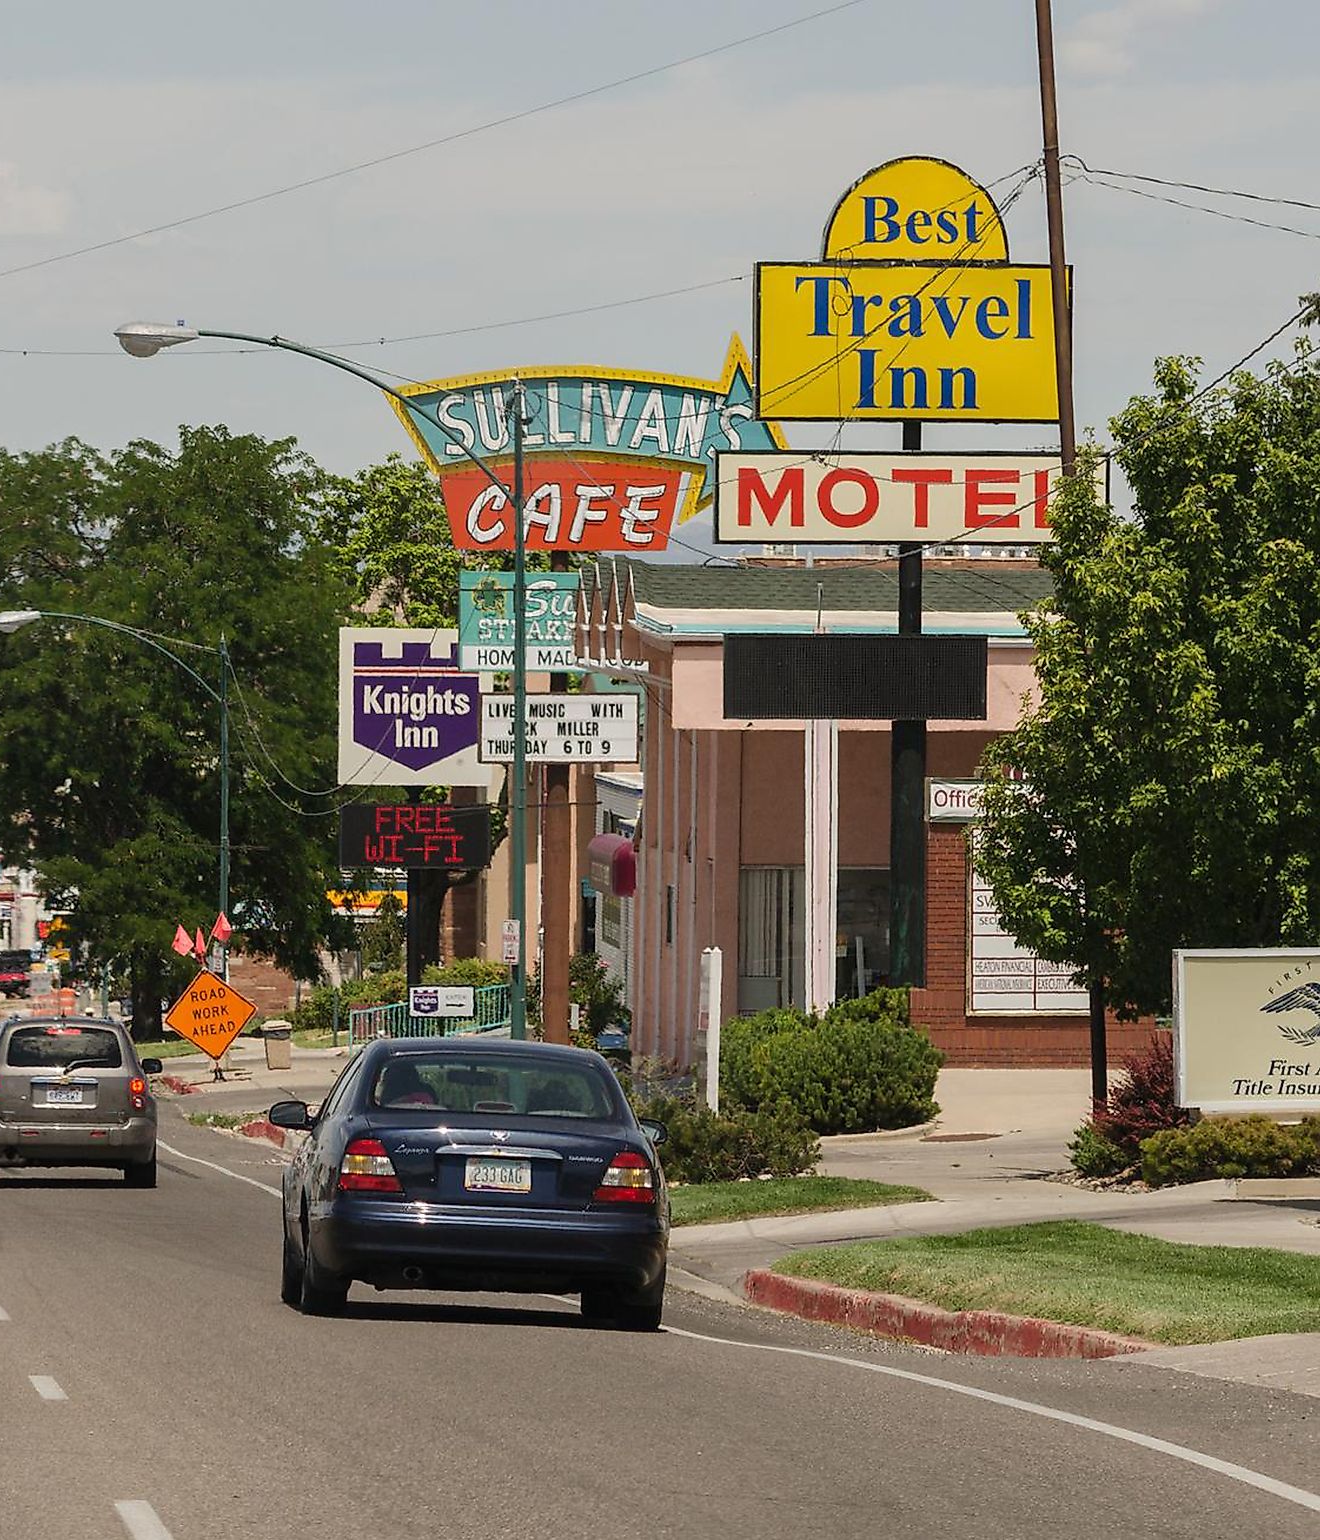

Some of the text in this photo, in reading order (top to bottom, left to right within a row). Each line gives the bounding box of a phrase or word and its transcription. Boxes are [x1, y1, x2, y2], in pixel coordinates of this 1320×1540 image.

[862, 196, 983, 245] Best
[794, 275, 1034, 340] Travel
[852, 348, 980, 410] Inn
[436, 381, 753, 461] SULLIVAN'S
[736, 467, 1053, 529] MOTEL
[466, 483, 666, 545] CAFE
[525, 579, 576, 617] Su
[477, 649, 515, 666] HOM
[363, 684, 471, 722] Knights
[529, 703, 566, 718] MUSIC
[591, 703, 623, 718] WITH
[395, 718, 439, 748] Inn
[508, 721, 599, 737] JCK MILLER
[563, 740, 572, 755] 6
[577, 740, 592, 755] TO
[601, 740, 611, 755] 9
[375, 806, 456, 834] FREE
[364, 834, 464, 863] WI-FI
[1268, 960, 1312, 995] FIRST
[190, 987, 226, 1002] ROAD
[192, 1005, 230, 1020] WORK
[192, 1021, 236, 1037] AHEAD
[1268, 1059, 1311, 1076] First
[1232, 1079, 1320, 1096] Title Insu
